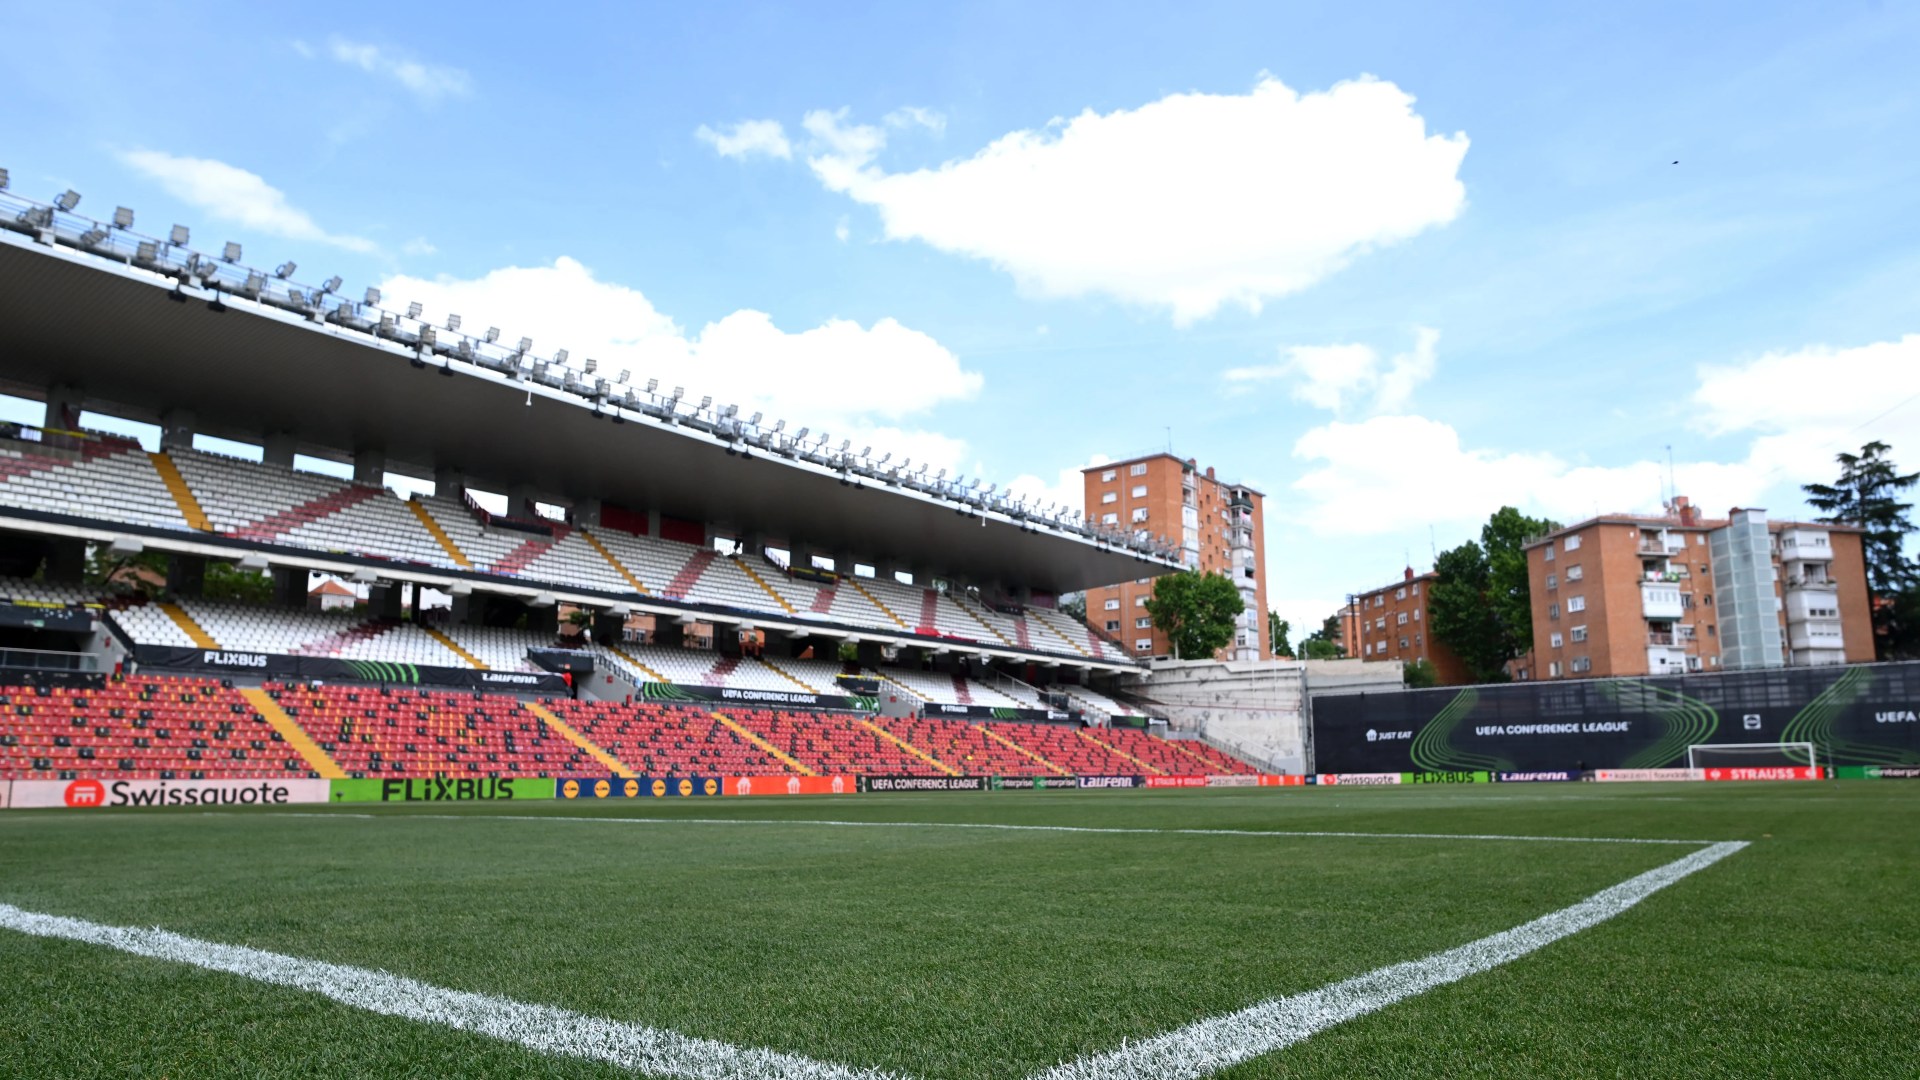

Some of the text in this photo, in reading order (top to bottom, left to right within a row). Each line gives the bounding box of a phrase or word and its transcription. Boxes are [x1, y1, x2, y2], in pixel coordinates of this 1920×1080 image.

[722, 689, 816, 704] UEFA CONFERENCE LEAGUE
[1875, 711, 1917, 723] UEFA
[1475, 721, 1629, 735] UEFA CONFERENCE LEAGUE
[1379, 731, 1412, 741] JUST EAT
[1337, 775, 1394, 785] Swissquote
[1730, 768, 1795, 780] STRAUSS
[871, 778, 979, 789] UEFA CONFERENCE LEAGUE
[110, 780, 289, 806] Swissquote
